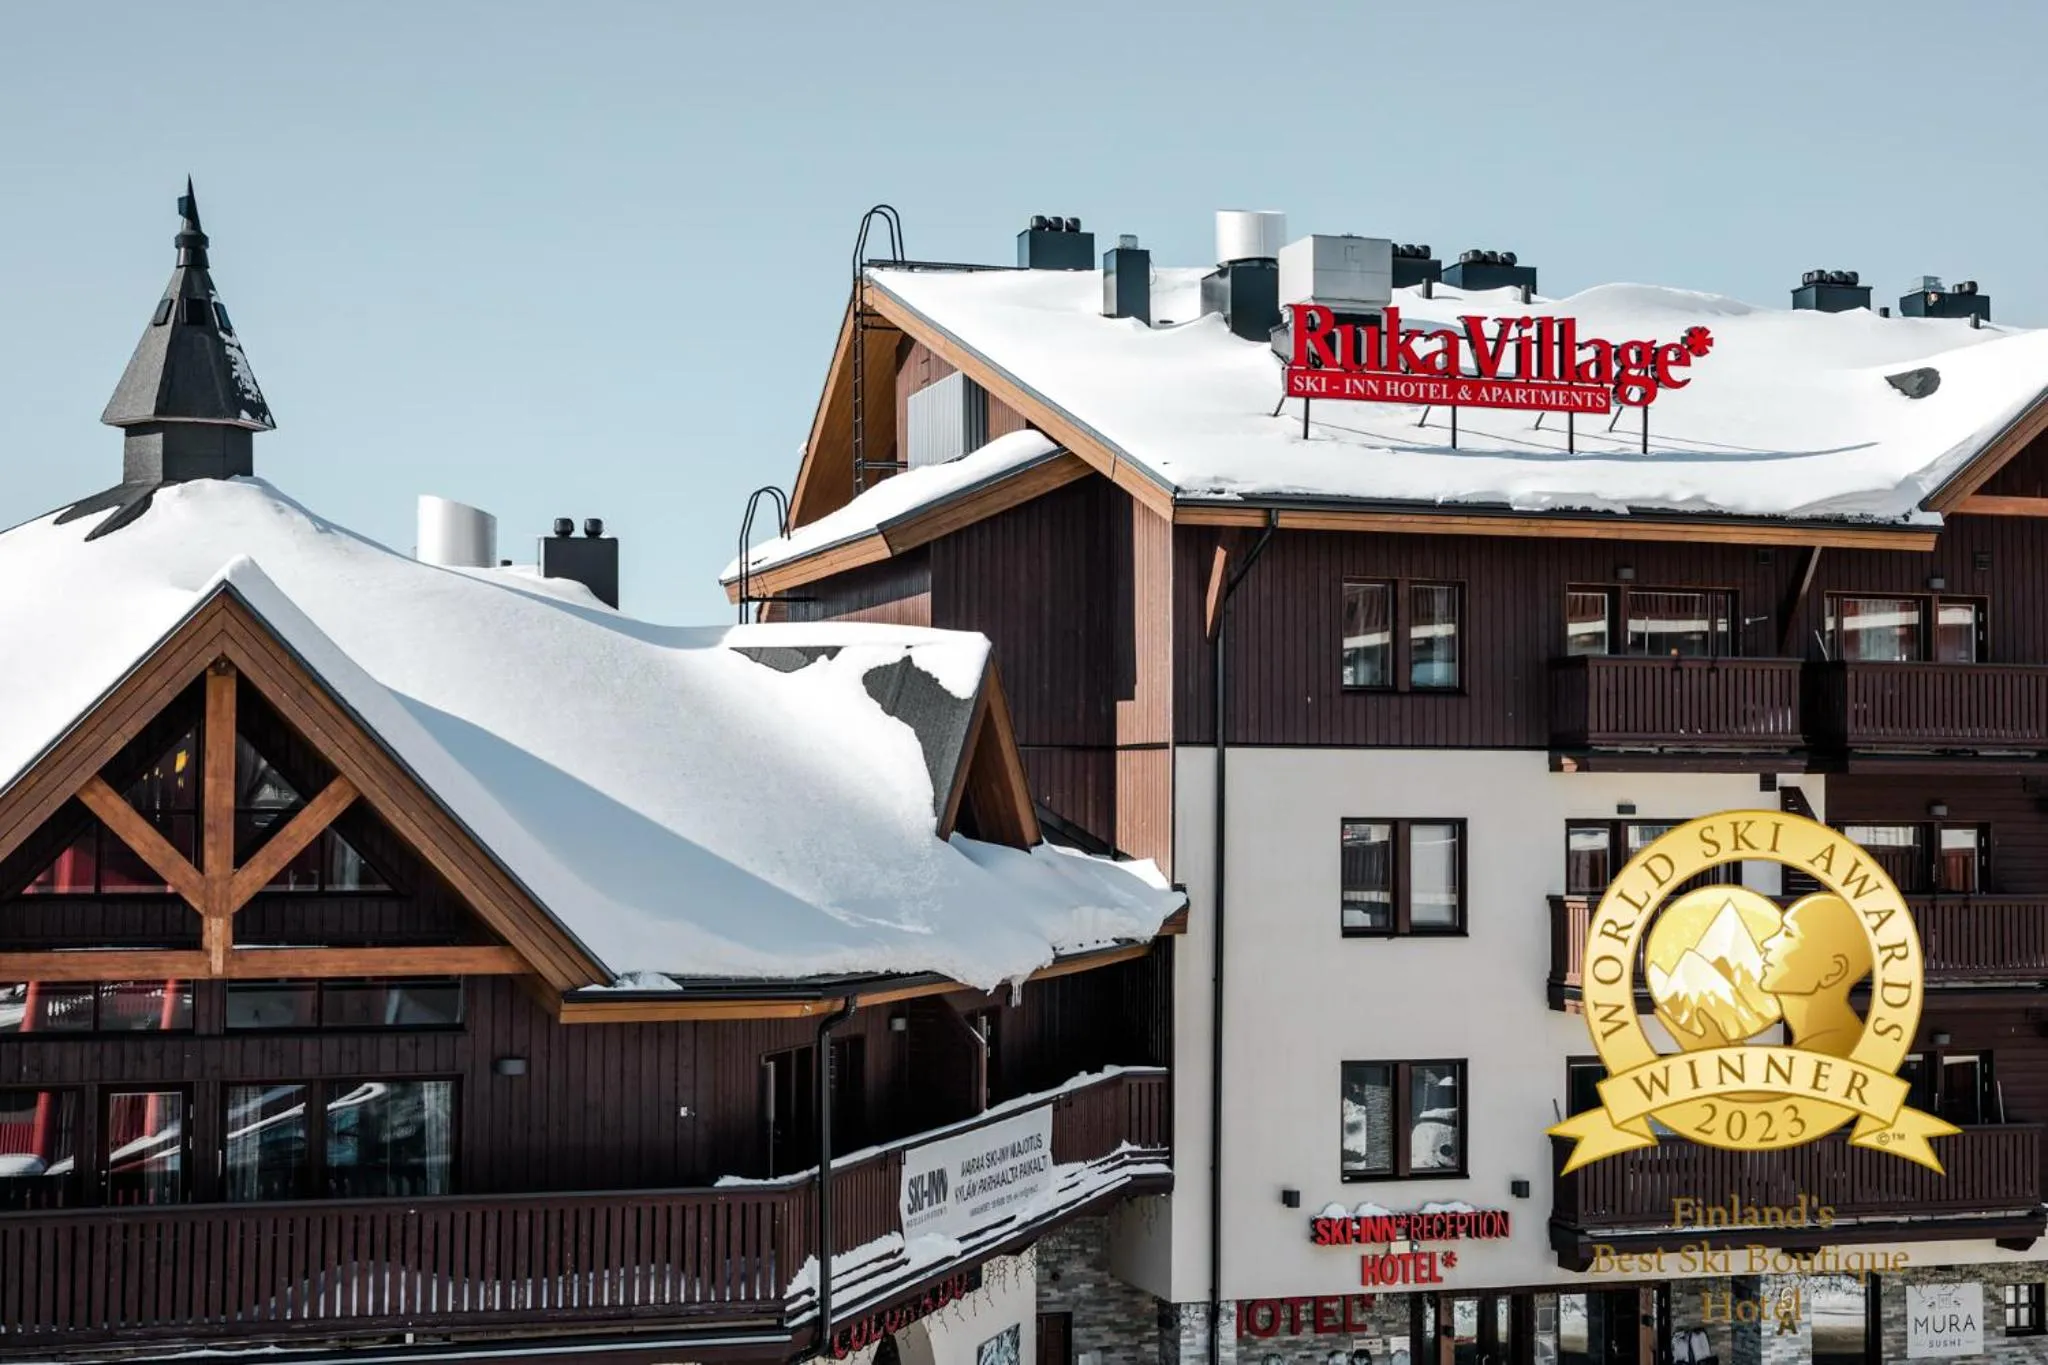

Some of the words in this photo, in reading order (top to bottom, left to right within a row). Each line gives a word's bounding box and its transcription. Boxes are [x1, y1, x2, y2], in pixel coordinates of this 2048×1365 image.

[1385, 381, 1454, 400] HOTEL
[1457, 384, 1472, 400] &
[1477, 386, 1607, 407] APARTMENTS
[907, 1167, 949, 1215] SKI-INN
[1312, 1215, 1397, 1246] SKI-INN
[1410, 1210, 1510, 1241] RECEPTION
[1360, 1252, 1443, 1287] HOTEL
[1914, 1313, 1976, 1335] MURA
[1928, 1338, 1961, 1349] SUSHI
